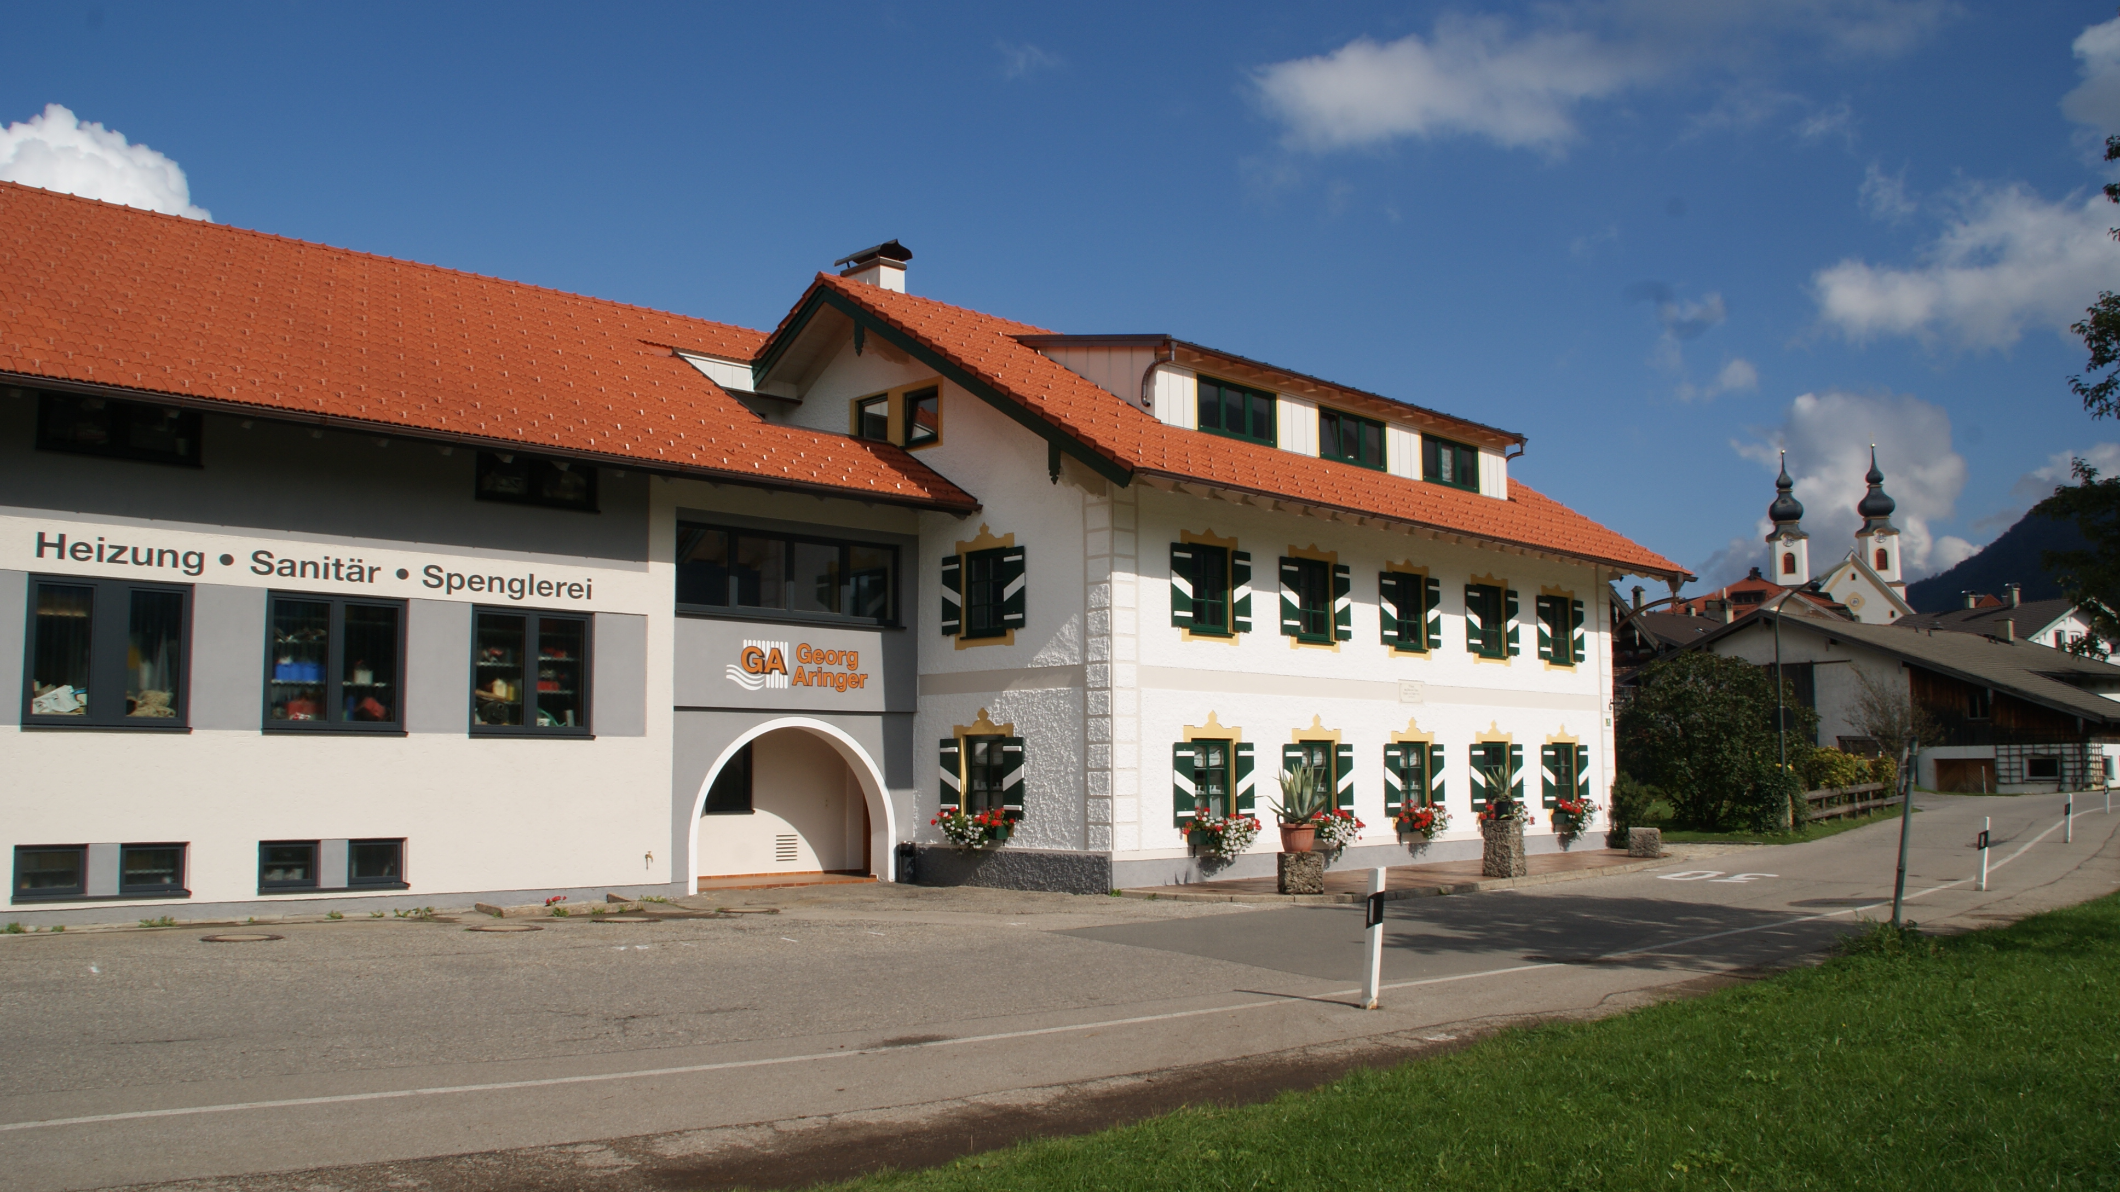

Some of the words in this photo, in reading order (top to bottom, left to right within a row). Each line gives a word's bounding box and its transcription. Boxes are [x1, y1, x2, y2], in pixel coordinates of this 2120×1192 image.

[36, 531, 205, 577] Heizung
[250, 549, 382, 584] Sanitär
[422, 564, 593, 601] Spenglerei
[741, 645, 788, 675] GA
[795, 642, 859, 671] Georg
[791, 665, 868, 693] Aringer
